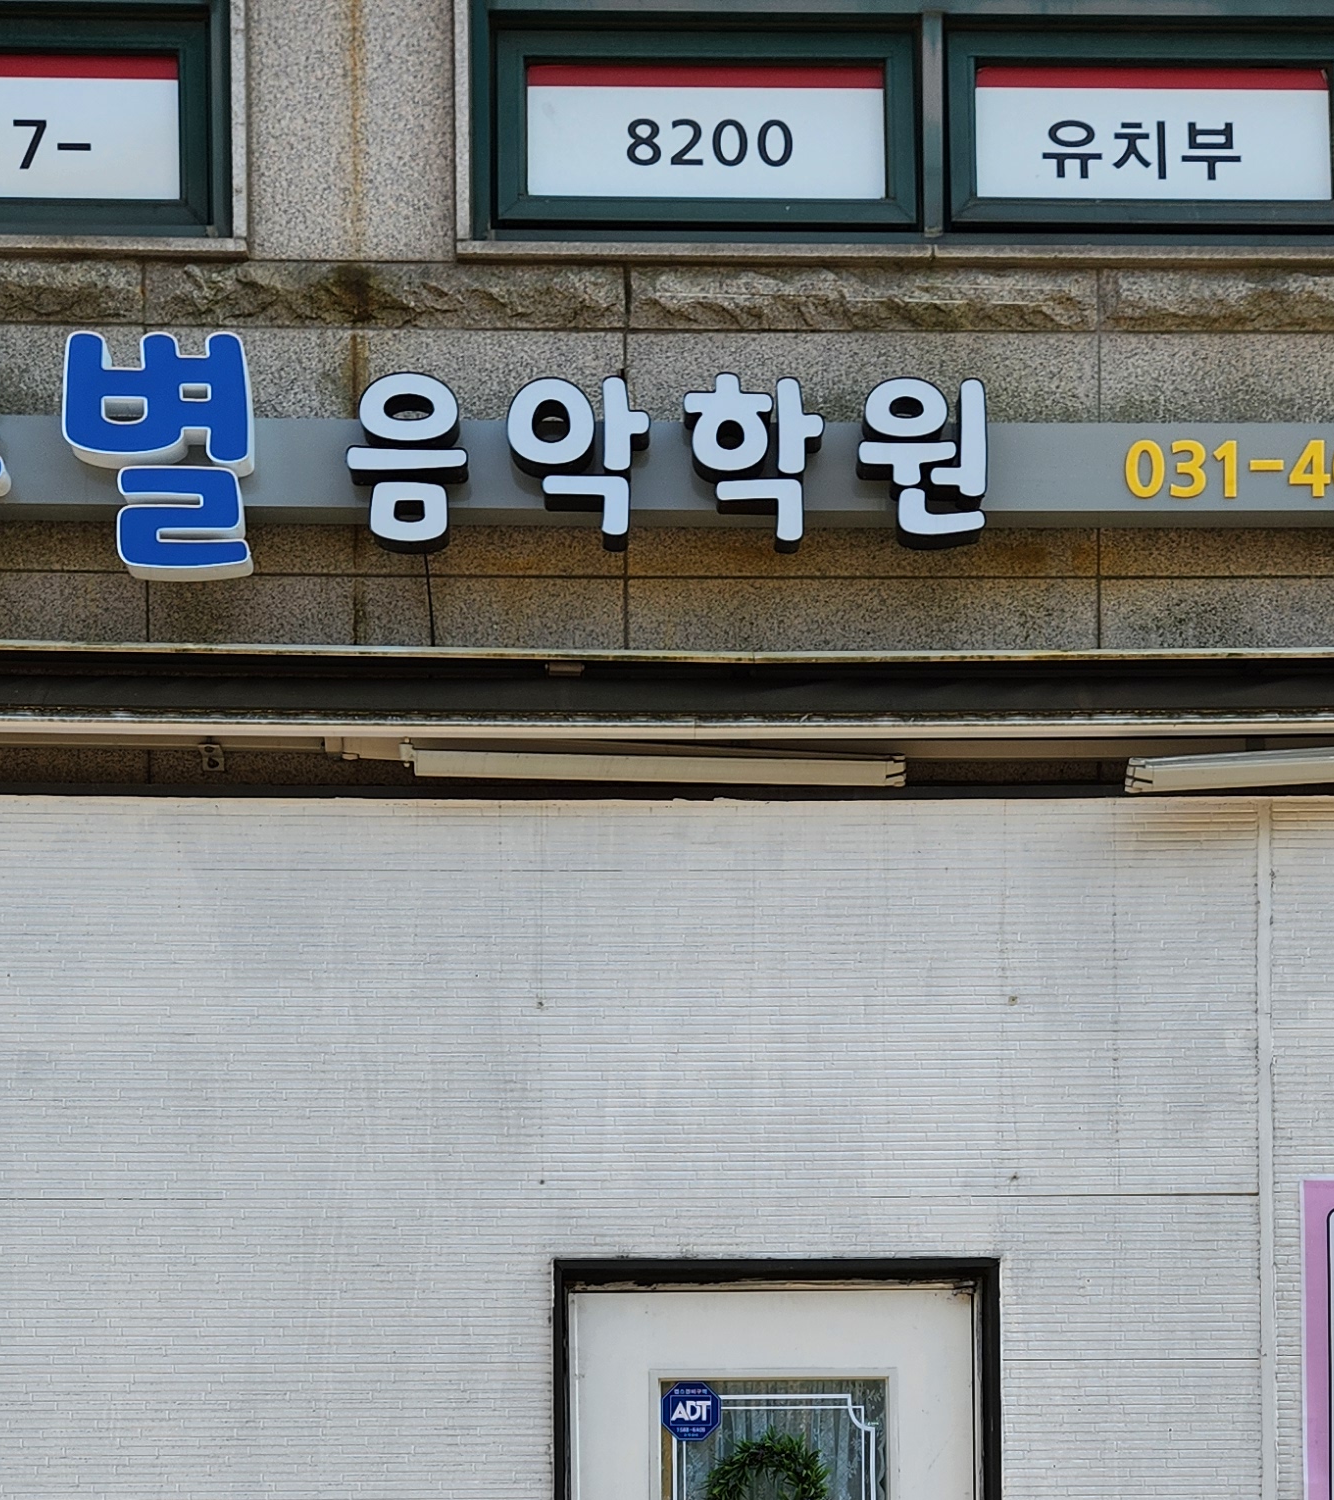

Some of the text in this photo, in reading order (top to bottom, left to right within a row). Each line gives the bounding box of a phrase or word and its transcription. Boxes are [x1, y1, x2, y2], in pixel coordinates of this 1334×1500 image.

[627, 119, 793, 167] 8200
[1042, 120, 1241, 180] 유치부
[347, 374, 986, 546] 음악학원
[671, 1401, 711, 1421] ADT
